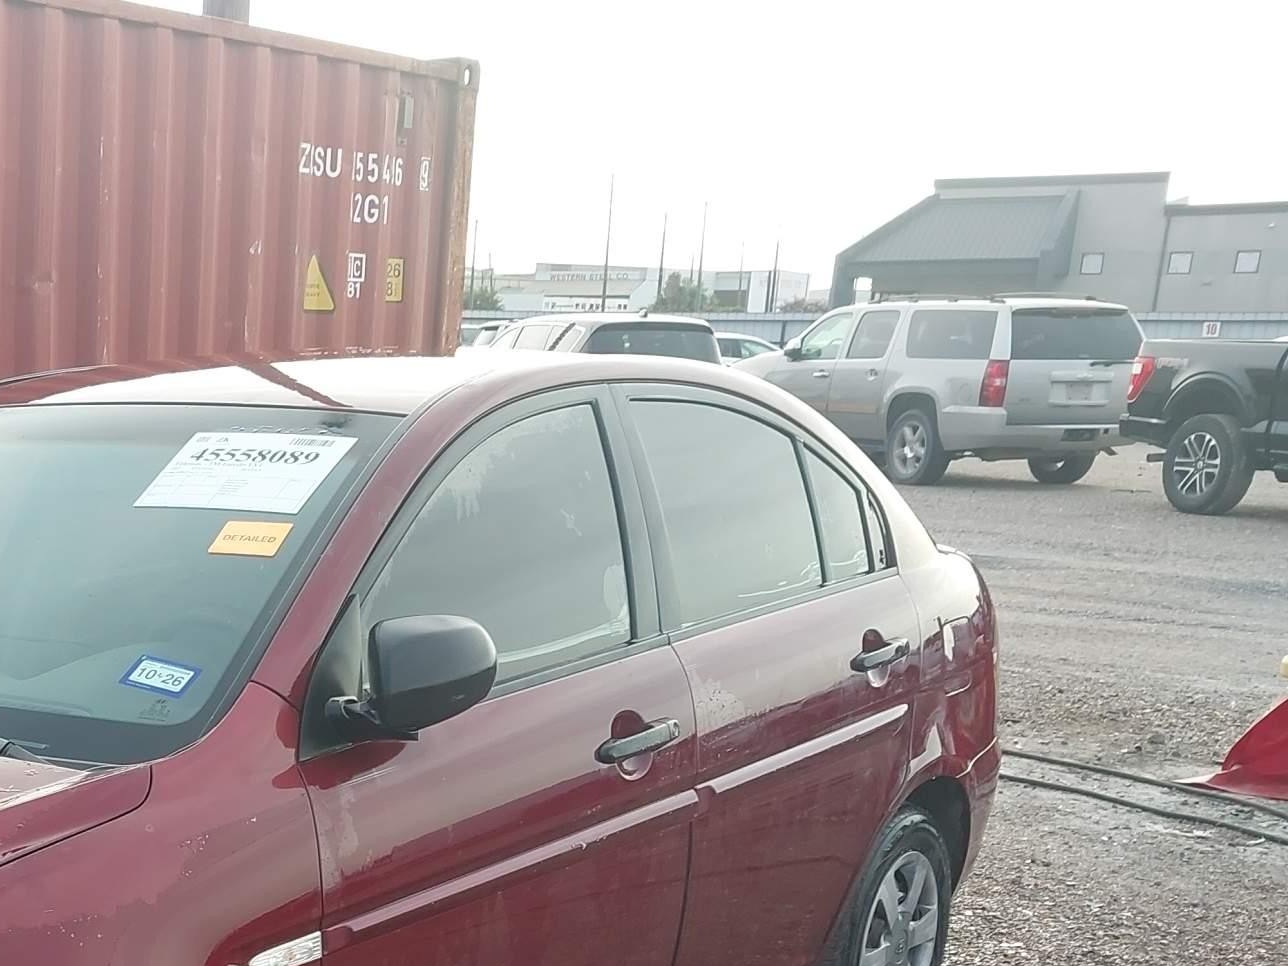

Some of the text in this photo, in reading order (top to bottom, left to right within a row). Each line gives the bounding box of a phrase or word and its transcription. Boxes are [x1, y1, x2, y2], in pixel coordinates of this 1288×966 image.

[299, 142, 343, 178] ZSU
[190, 447, 321, 465] 45558089
[222, 534, 277, 543] DETAILED
